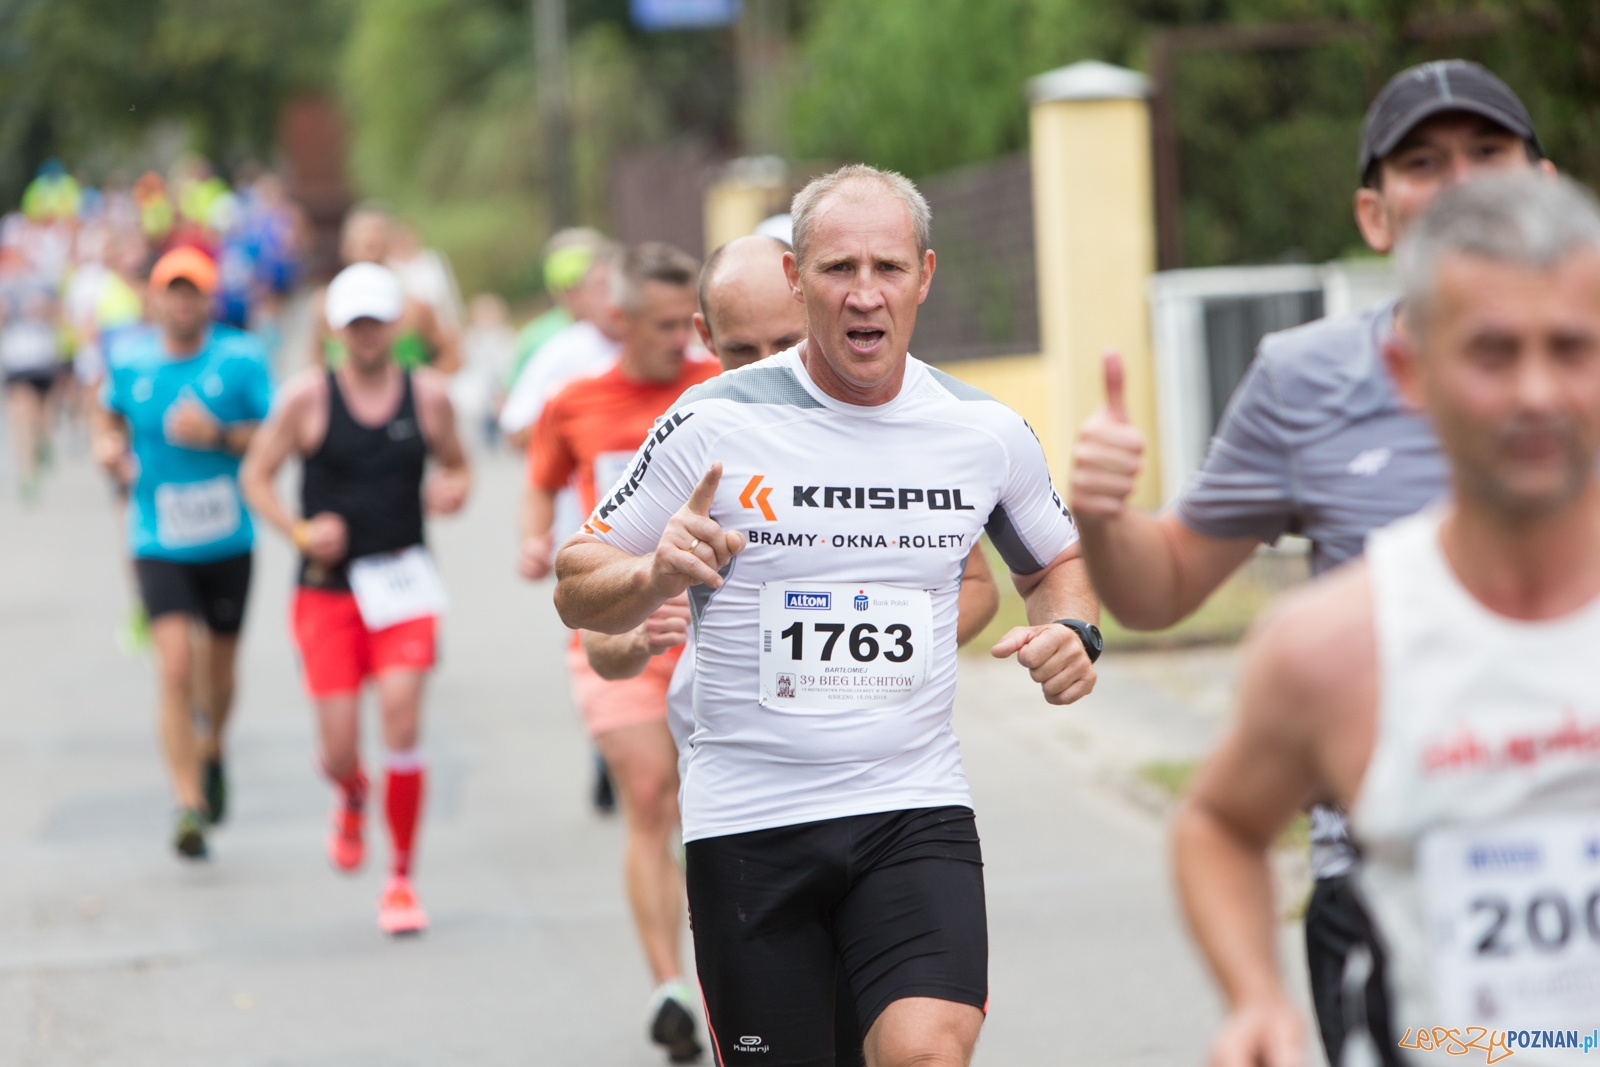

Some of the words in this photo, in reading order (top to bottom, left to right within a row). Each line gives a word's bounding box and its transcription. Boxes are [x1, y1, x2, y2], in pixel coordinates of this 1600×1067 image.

[599, 412, 695, 520] KRISPOL
[793, 485, 976, 511] KRISPOL
[748, 530, 818, 547] BRAMY
[832, 534, 888, 548] OKNA
[899, 533, 966, 549] ROLETY
[891, 599, 909, 607] Polski
[781, 621, 914, 663] 1763
[800, 674, 815, 687] 39
[819, 675, 849, 686] BIEG
[853, 674, 916, 687] LECHITÓW
[733, 1044, 770, 1053] Kalenji
